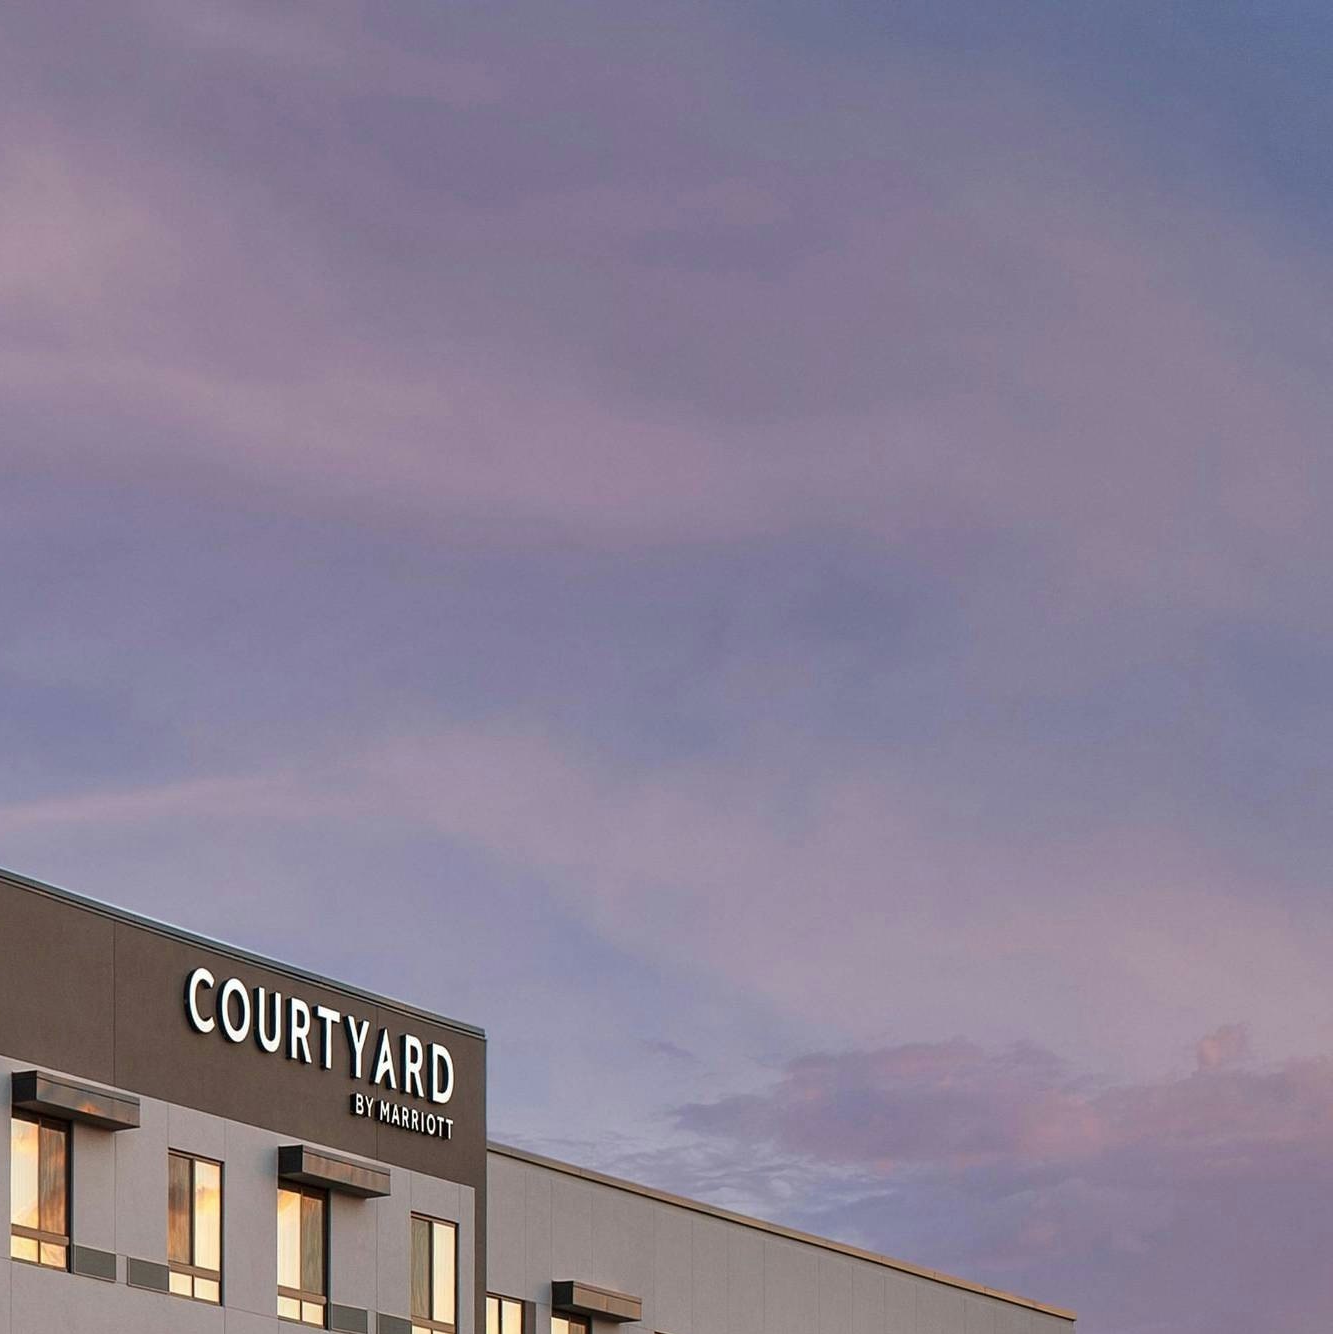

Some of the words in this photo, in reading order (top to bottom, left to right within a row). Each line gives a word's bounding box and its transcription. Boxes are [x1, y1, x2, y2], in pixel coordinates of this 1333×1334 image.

[188, 967, 455, 1104] COURTYARD
[355, 1093, 375, 1118] BY
[379, 1100, 454, 1140] MARRIOTT
